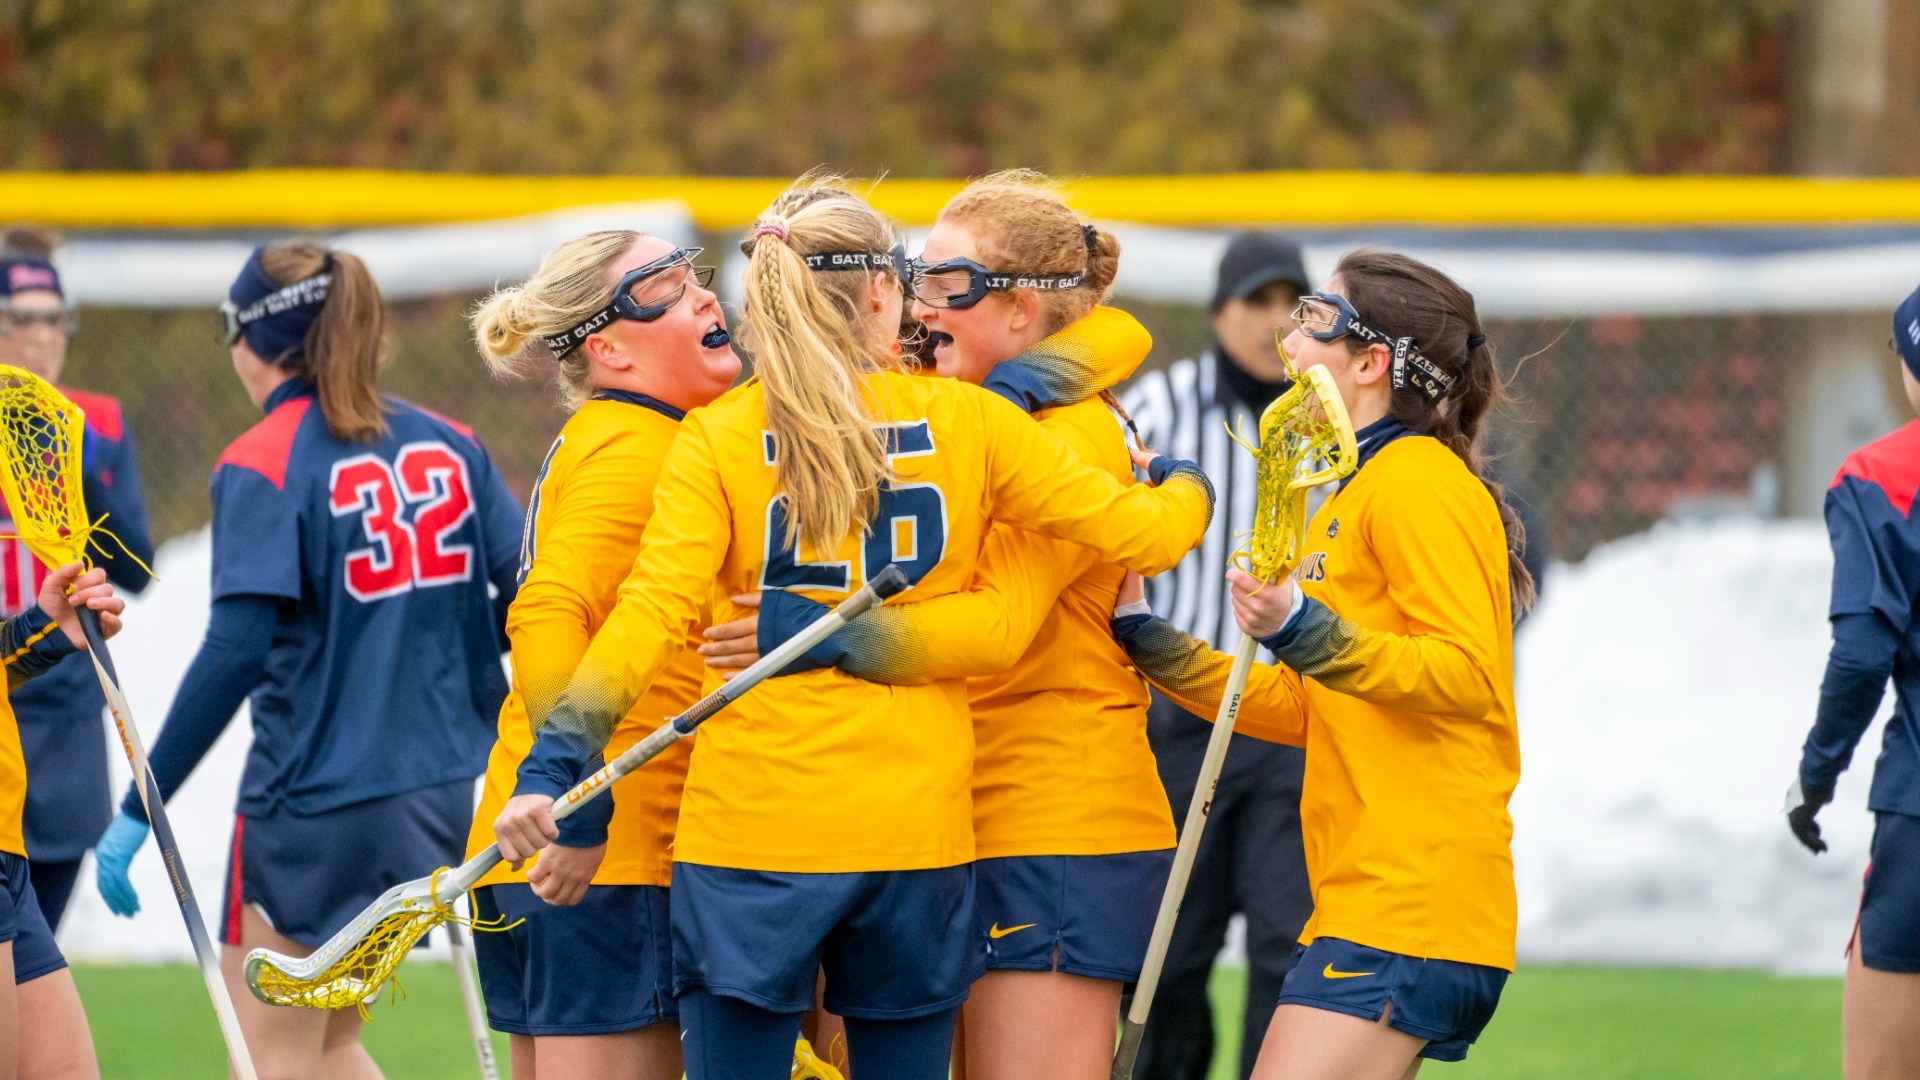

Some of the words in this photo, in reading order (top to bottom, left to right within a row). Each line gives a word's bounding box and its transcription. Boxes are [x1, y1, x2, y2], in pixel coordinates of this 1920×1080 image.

[805, 255, 824, 267] IT
[832, 254, 867, 265] GAIT
[1017, 278, 1054, 289] GAIT
[574, 310, 609, 338] GAIT
[329, 441, 475, 603] 32
[1227, 693, 1241, 720] GAIT
[566, 767, 614, 805] GAIT
